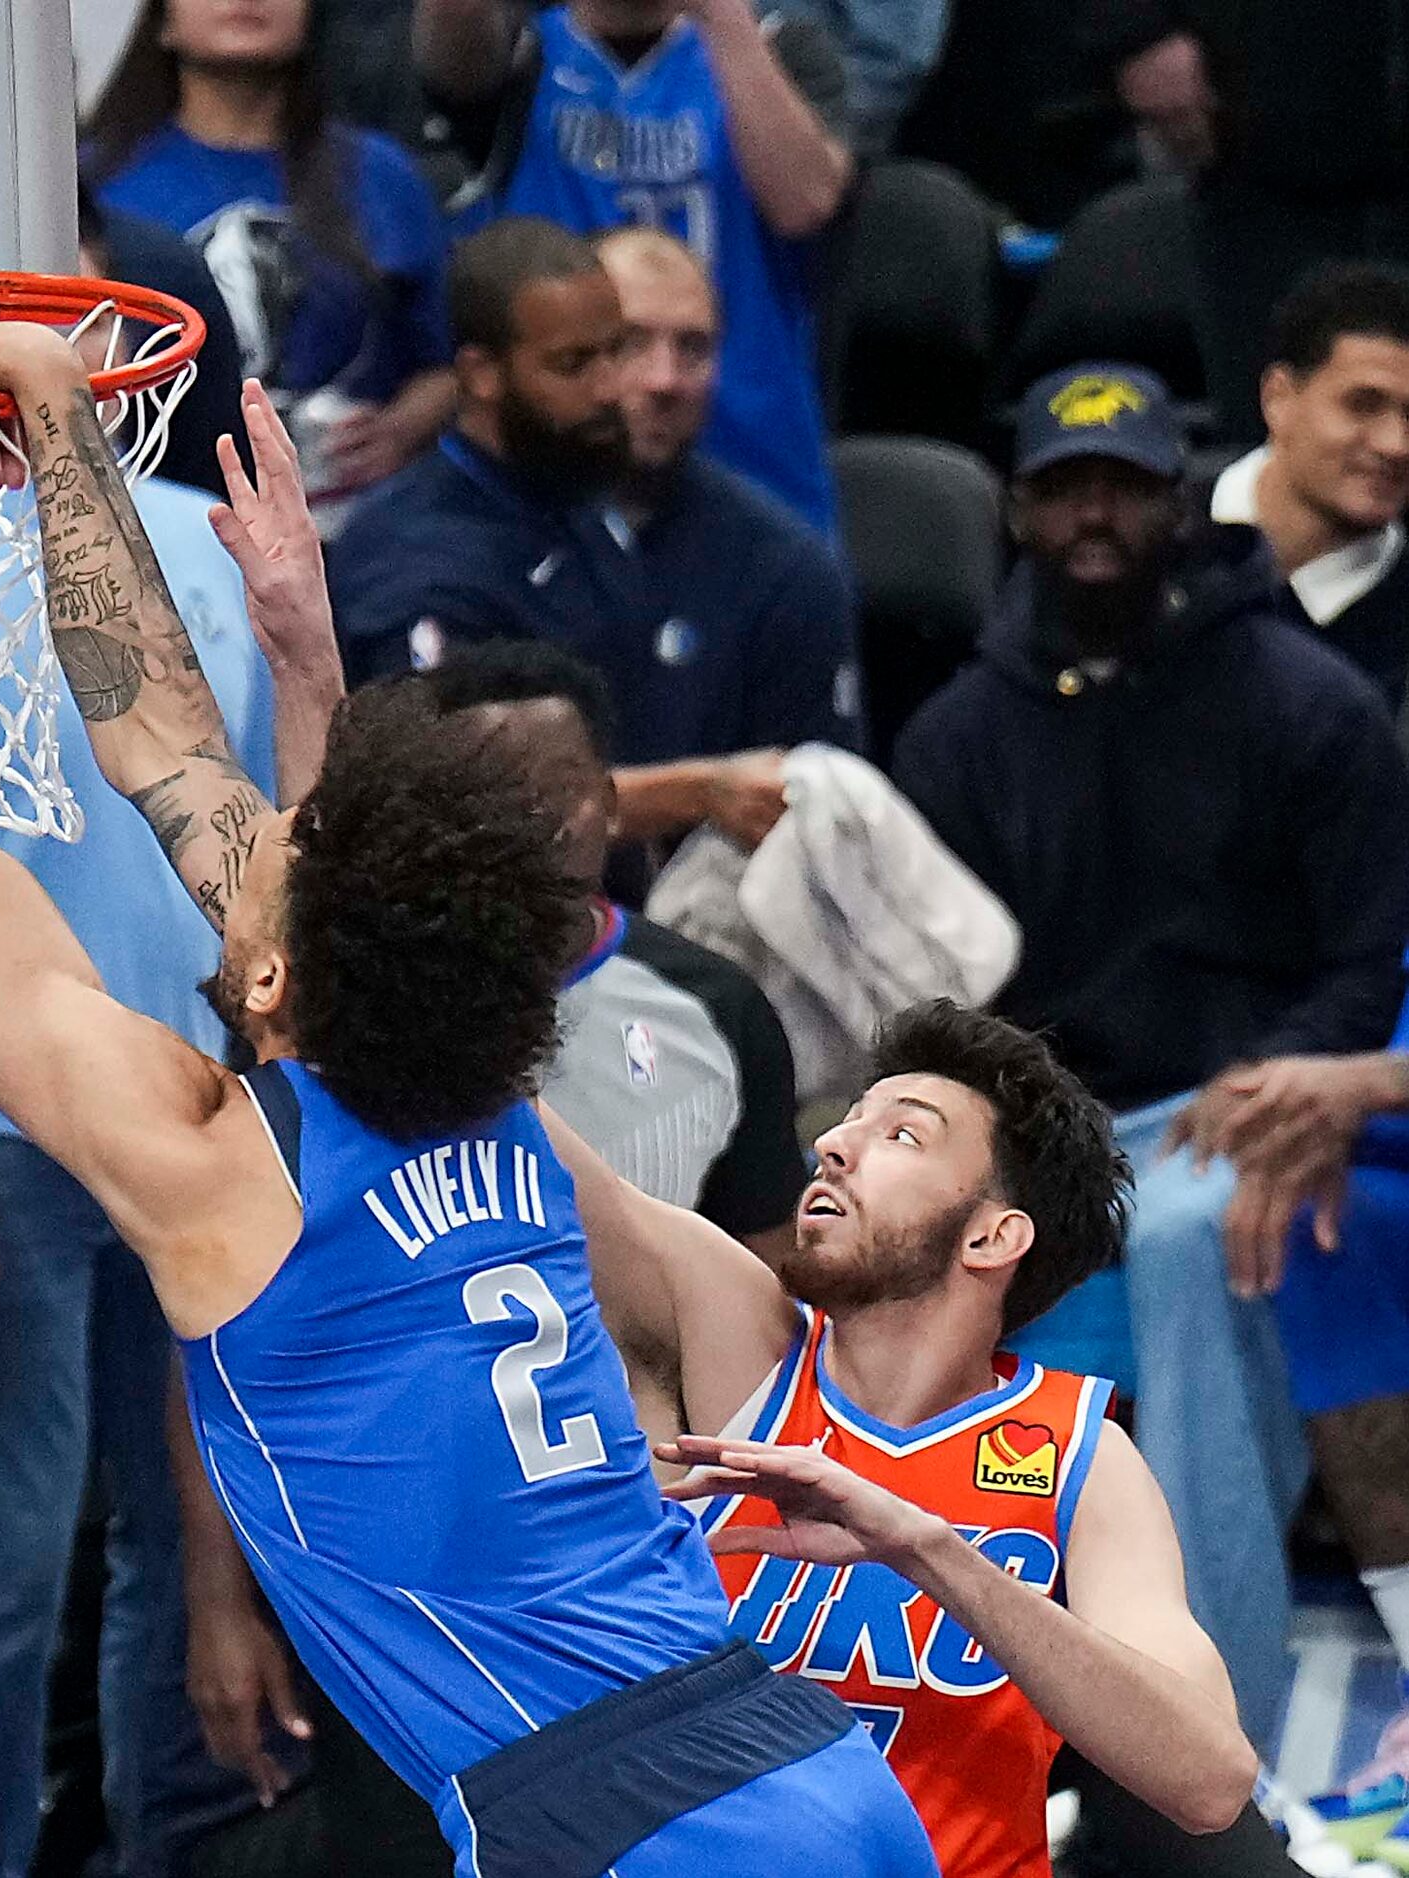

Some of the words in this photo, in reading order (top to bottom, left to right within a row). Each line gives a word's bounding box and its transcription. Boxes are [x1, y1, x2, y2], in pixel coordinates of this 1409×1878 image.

[363, 1139, 504, 1260] LIVELY
[513, 1144, 547, 1229] II
[462, 1262, 608, 1484] 2
